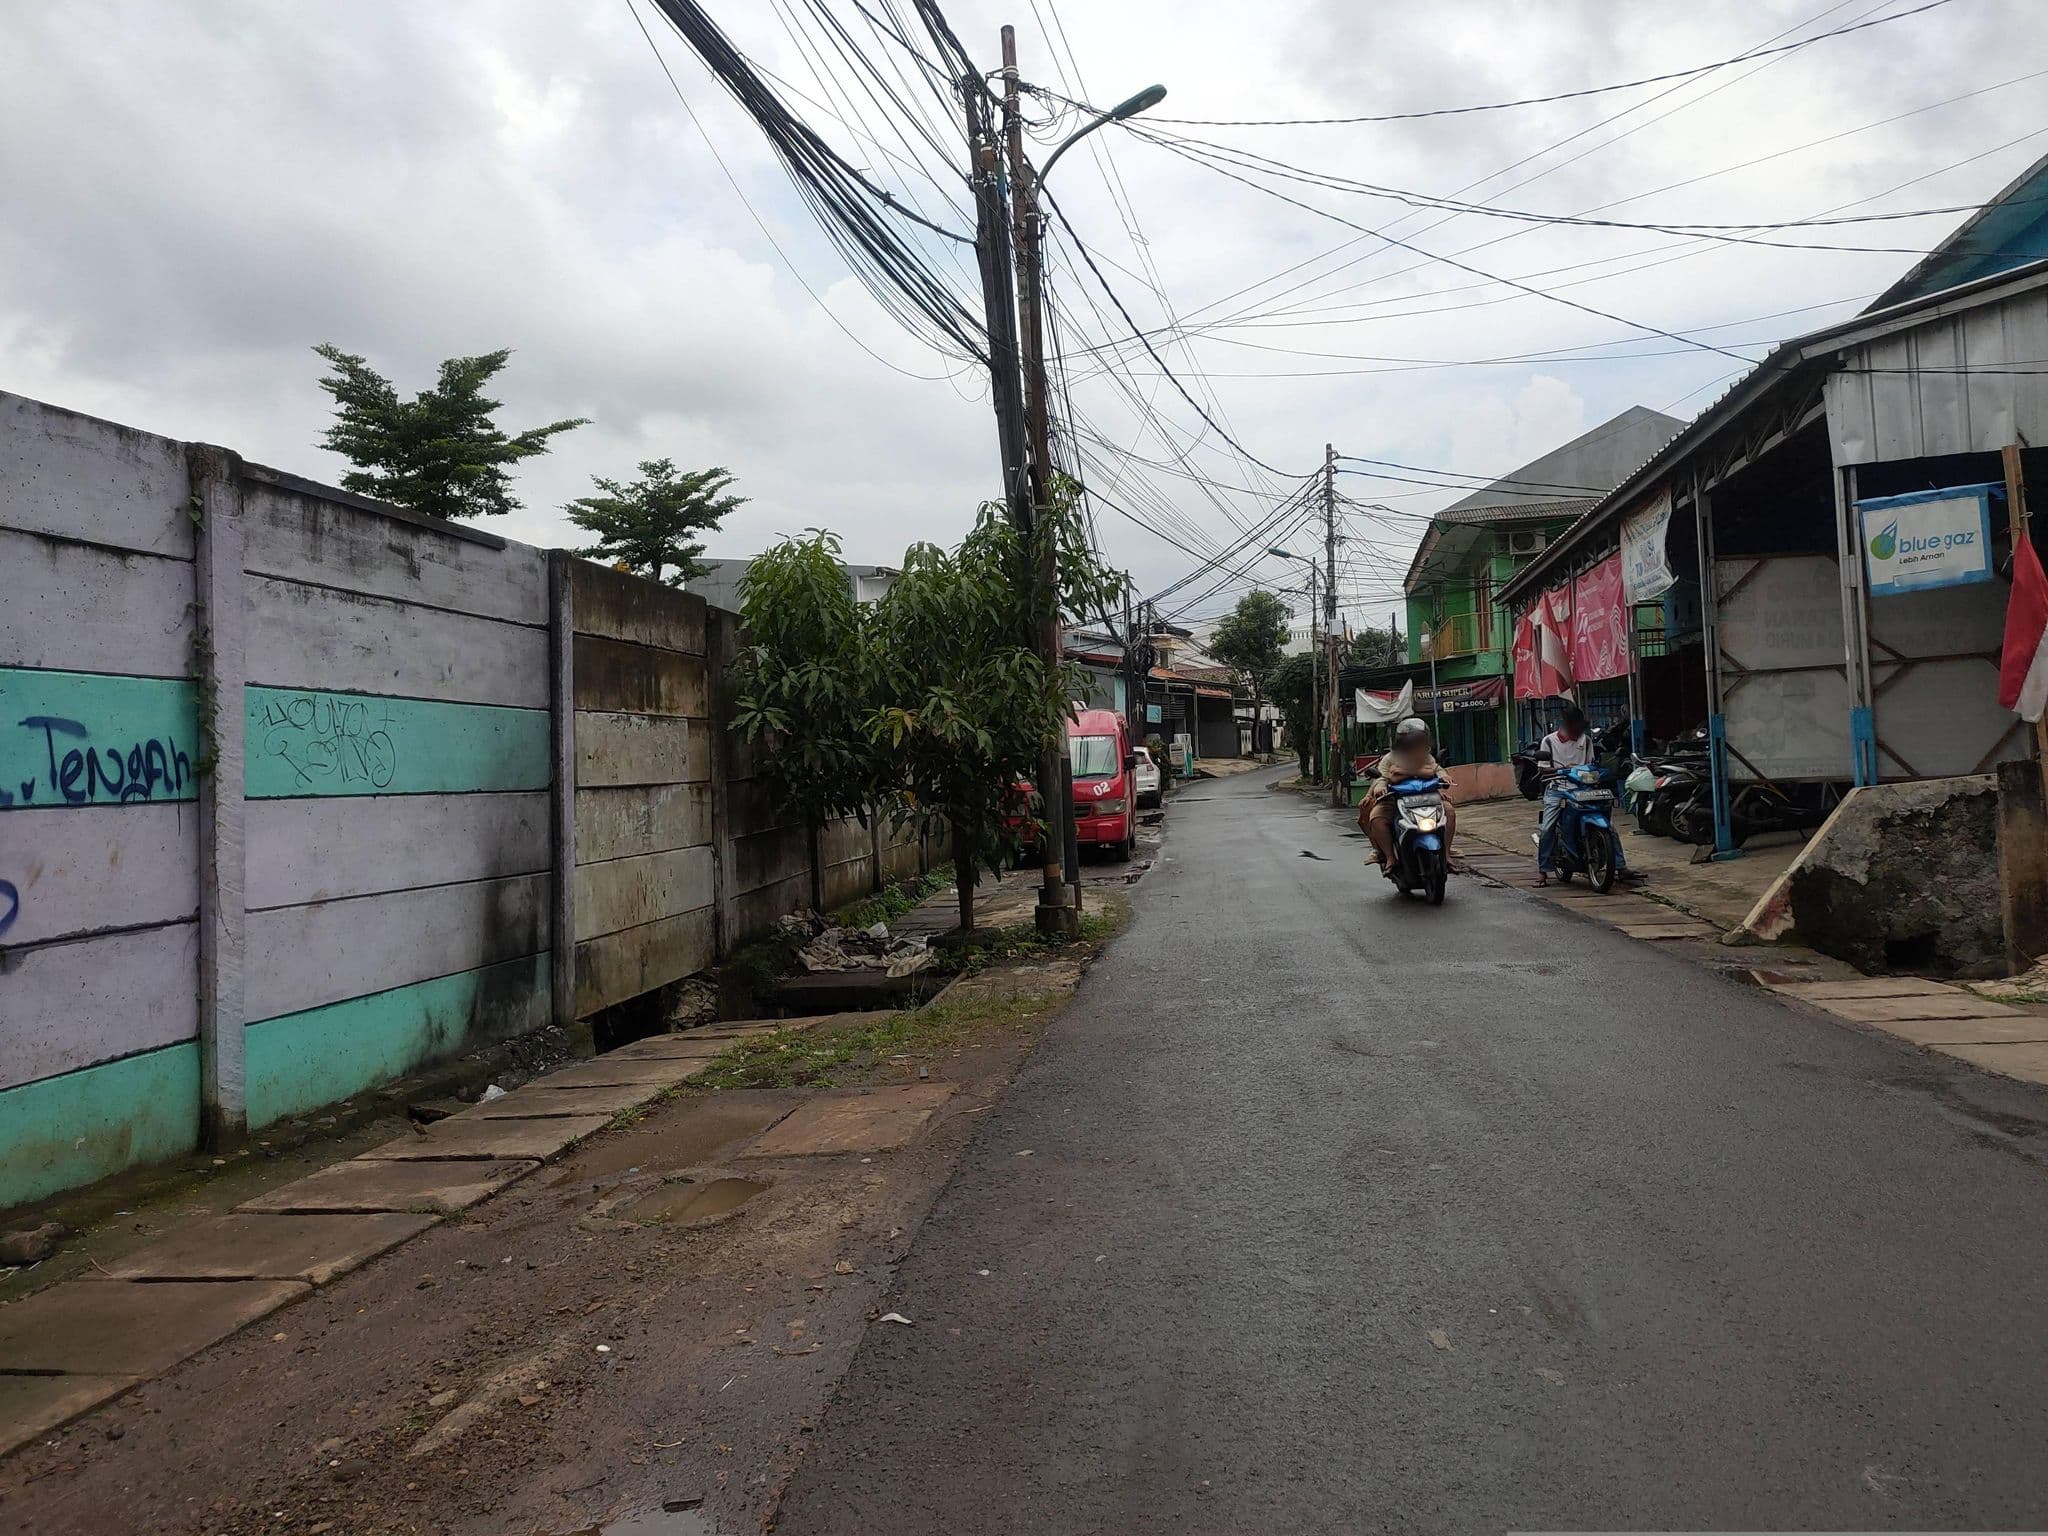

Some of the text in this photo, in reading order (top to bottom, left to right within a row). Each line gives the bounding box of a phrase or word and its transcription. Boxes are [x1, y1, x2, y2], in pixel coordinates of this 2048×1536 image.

[1899, 532, 1976, 554] blue gaz
[1899, 552, 1945, 565] Lebih Aman
[1442, 688, 1470, 697] SUPER
[1093, 781, 1111, 796] 02
